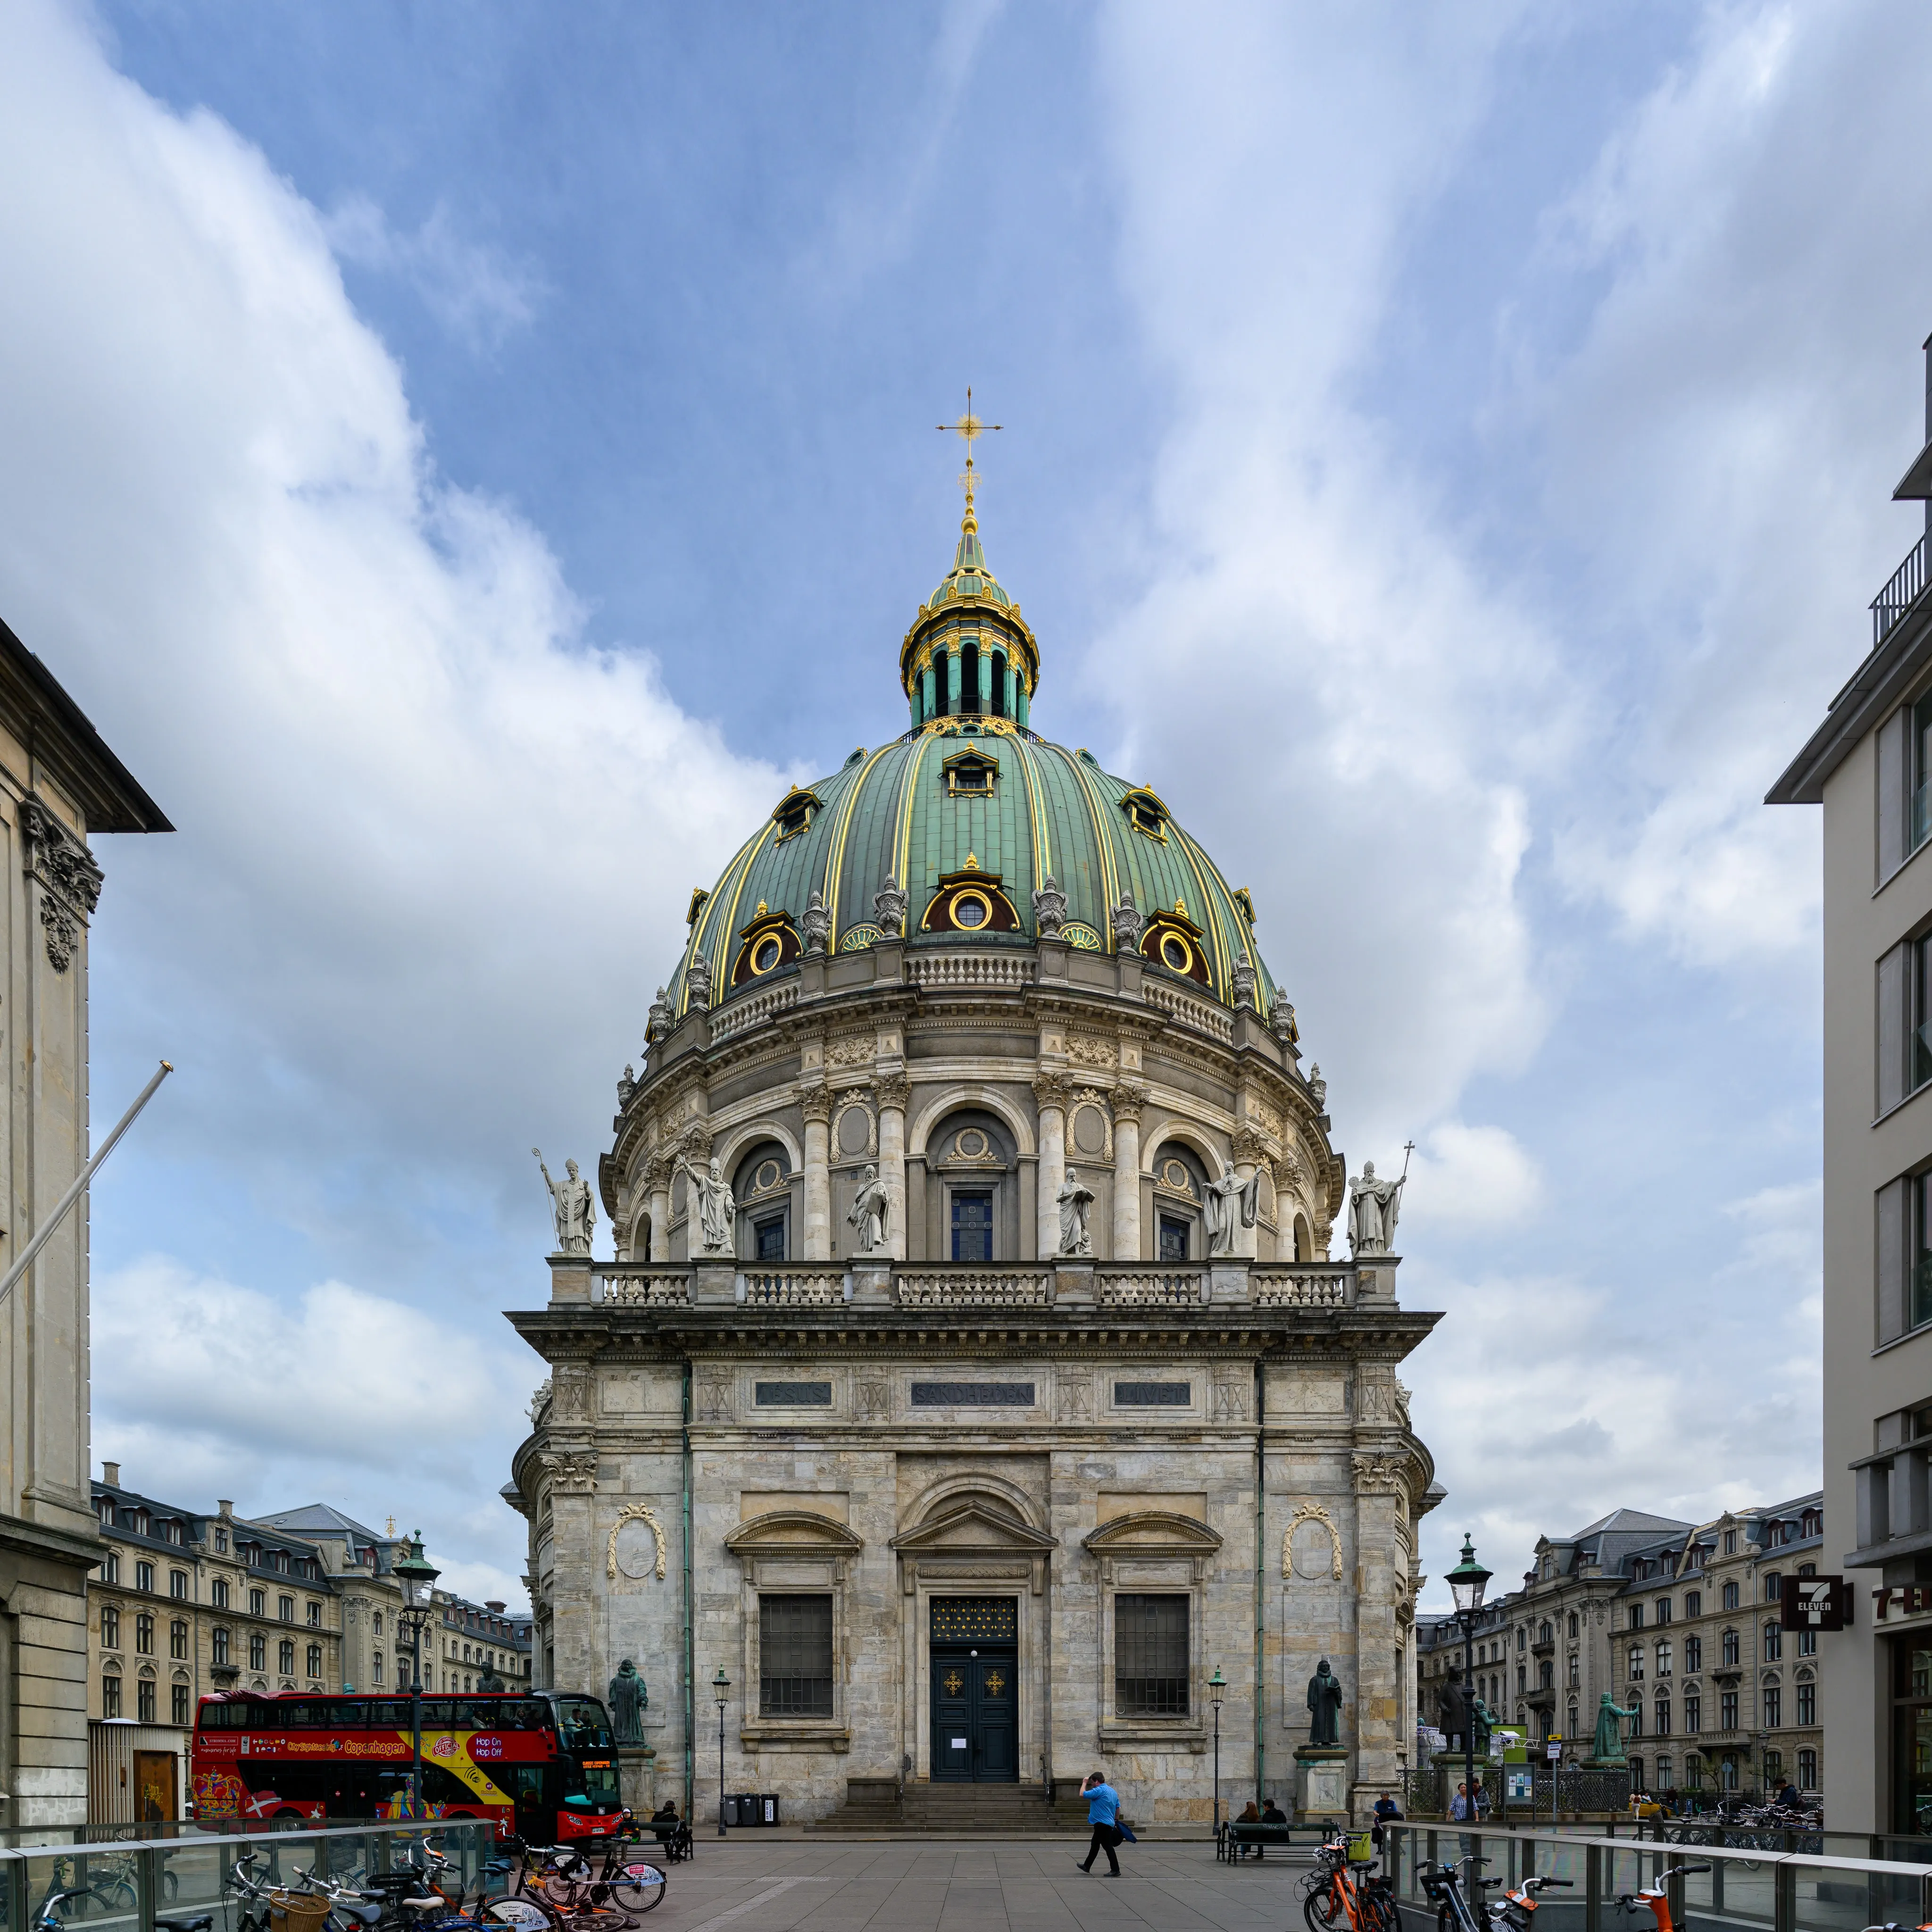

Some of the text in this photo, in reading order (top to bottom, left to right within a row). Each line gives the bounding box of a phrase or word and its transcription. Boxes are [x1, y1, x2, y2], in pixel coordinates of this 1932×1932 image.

[916, 1387, 1032, 1403] SANDHEDEN
[476, 1737, 501, 1747] Hop On
[344, 1740, 405, 1756] Copenhagen
[435, 1743, 459, 1753] OFFICIAL
[476, 1748, 502, 1757] Hop Off
